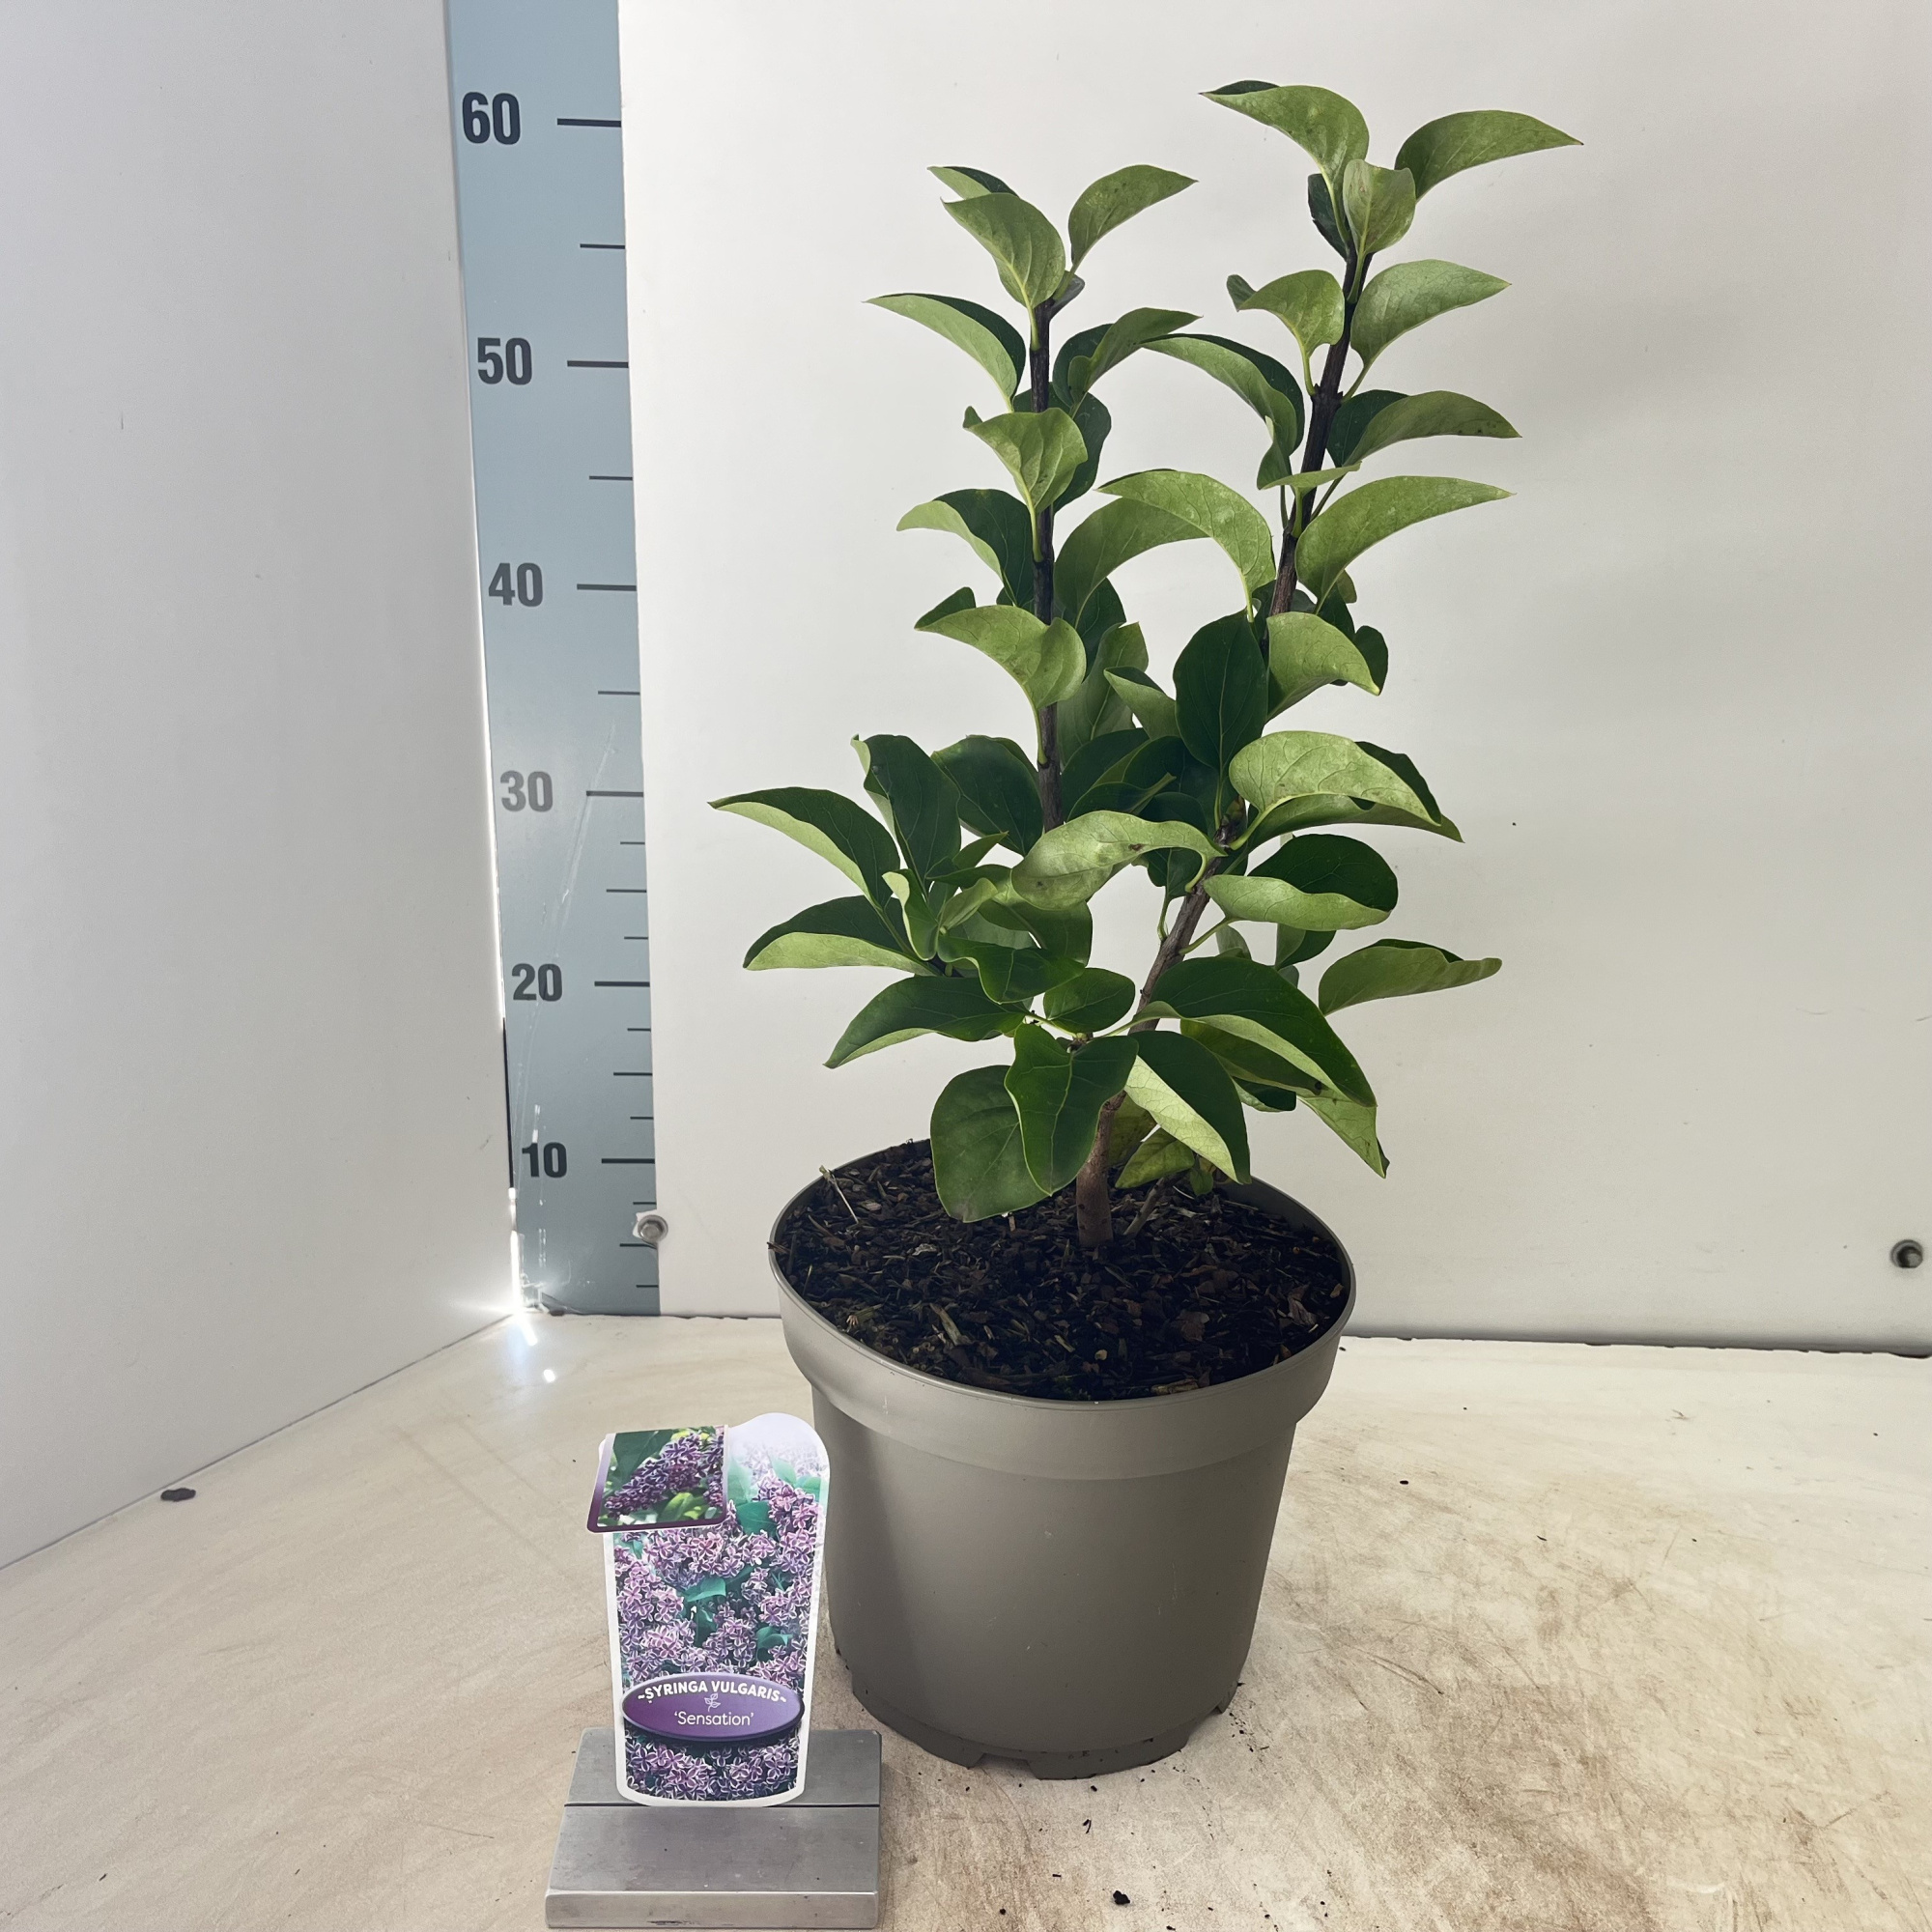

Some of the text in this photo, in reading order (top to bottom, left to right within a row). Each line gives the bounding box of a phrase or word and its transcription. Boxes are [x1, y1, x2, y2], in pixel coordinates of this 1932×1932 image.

[463, 92, 521, 145] 60
[477, 337, 533, 385] 50
[488, 563, 544, 607] 40
[499, 771, 554, 812] 30
[512, 963, 563, 1002] 20
[521, 1143, 568, 1179] 10
